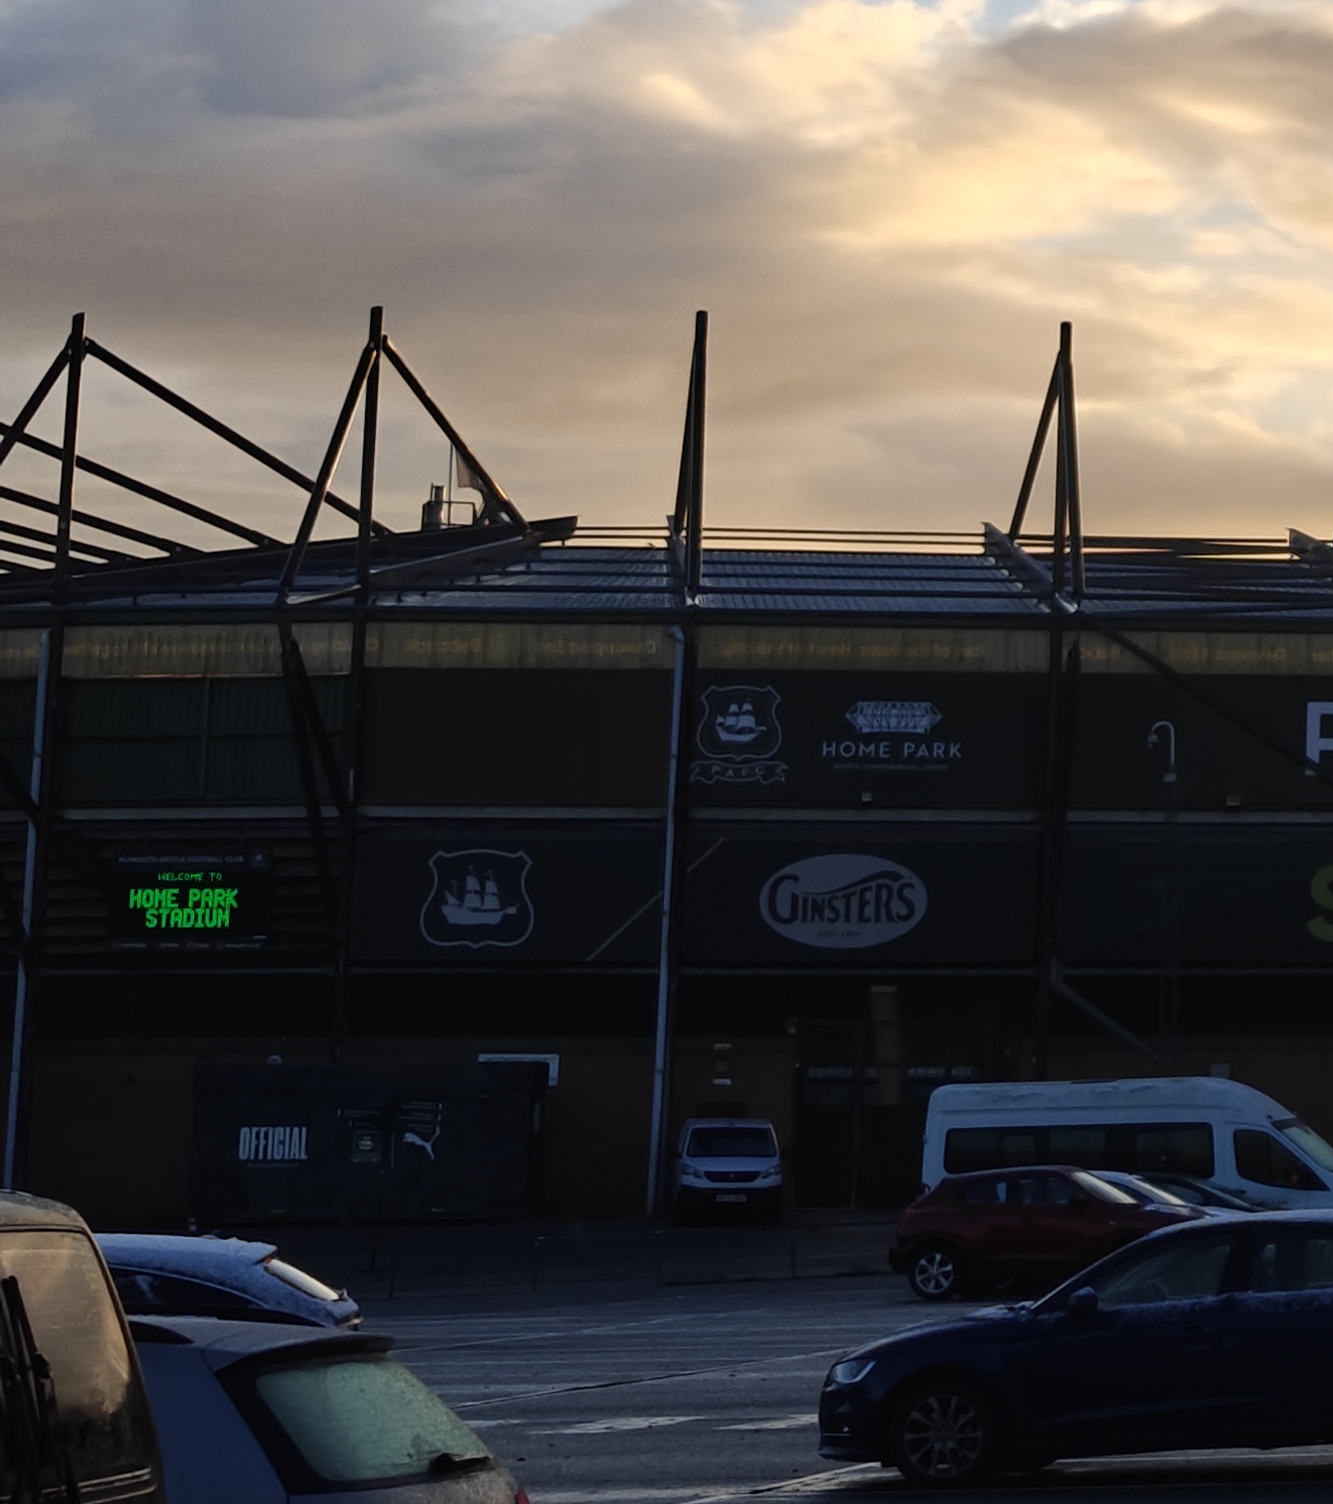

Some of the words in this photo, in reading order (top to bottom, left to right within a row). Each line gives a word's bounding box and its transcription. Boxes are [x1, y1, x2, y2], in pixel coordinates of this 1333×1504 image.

[822, 740, 891, 759] HOME
[903, 741, 962, 759] PARK
[157, 871, 204, 883] WELCOME
[208, 871, 223, 882] TO
[129, 887, 181, 909] HOME
[187, 887, 239, 909] PARK
[145, 908, 231, 929] STADIUM
[238, 1126, 309, 1161] OFFICIAL
